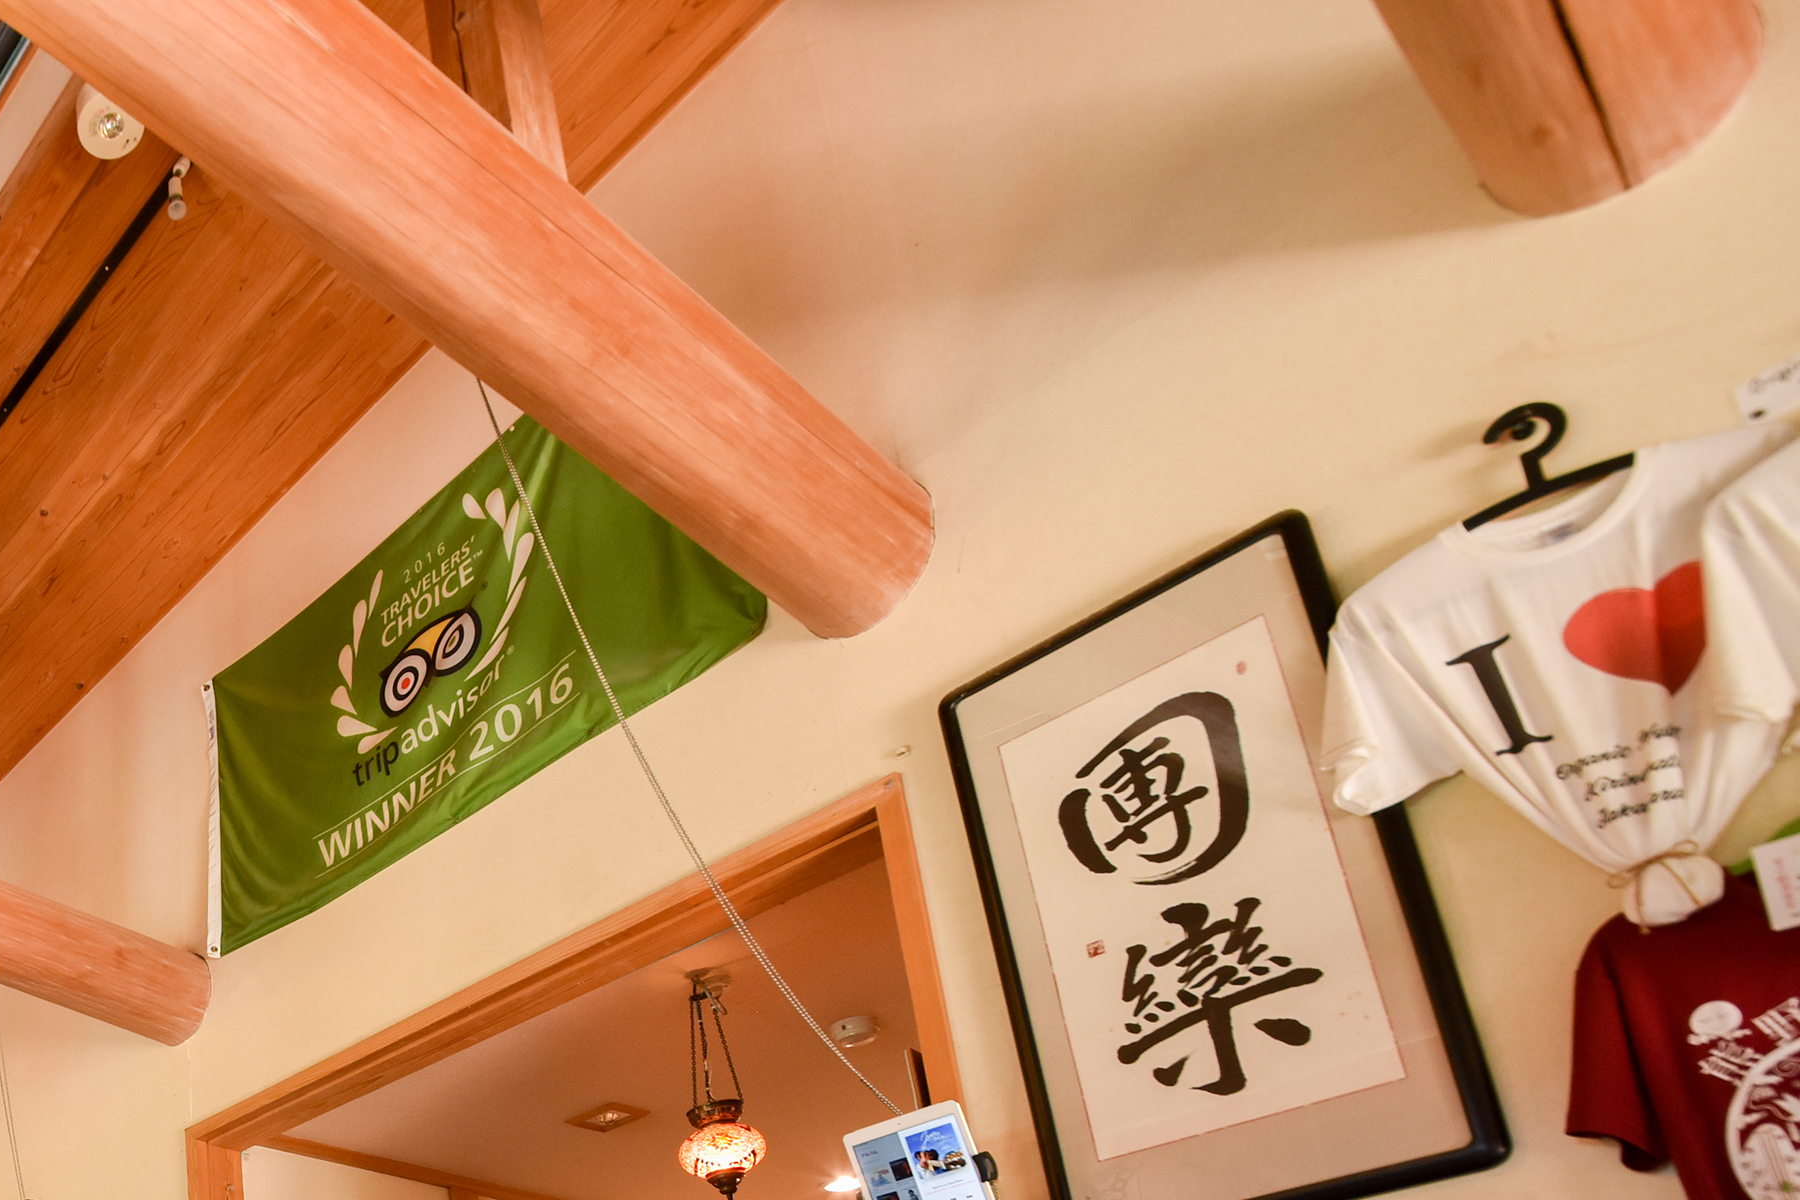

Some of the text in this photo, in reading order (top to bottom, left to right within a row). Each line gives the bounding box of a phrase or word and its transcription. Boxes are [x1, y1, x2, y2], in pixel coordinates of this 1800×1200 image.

[403, 541, 446, 583] 2016
[352, 651, 506, 788] tripadvisor
[1444, 633, 1555, 757] I
[317, 662, 575, 870] WINNER 2016
